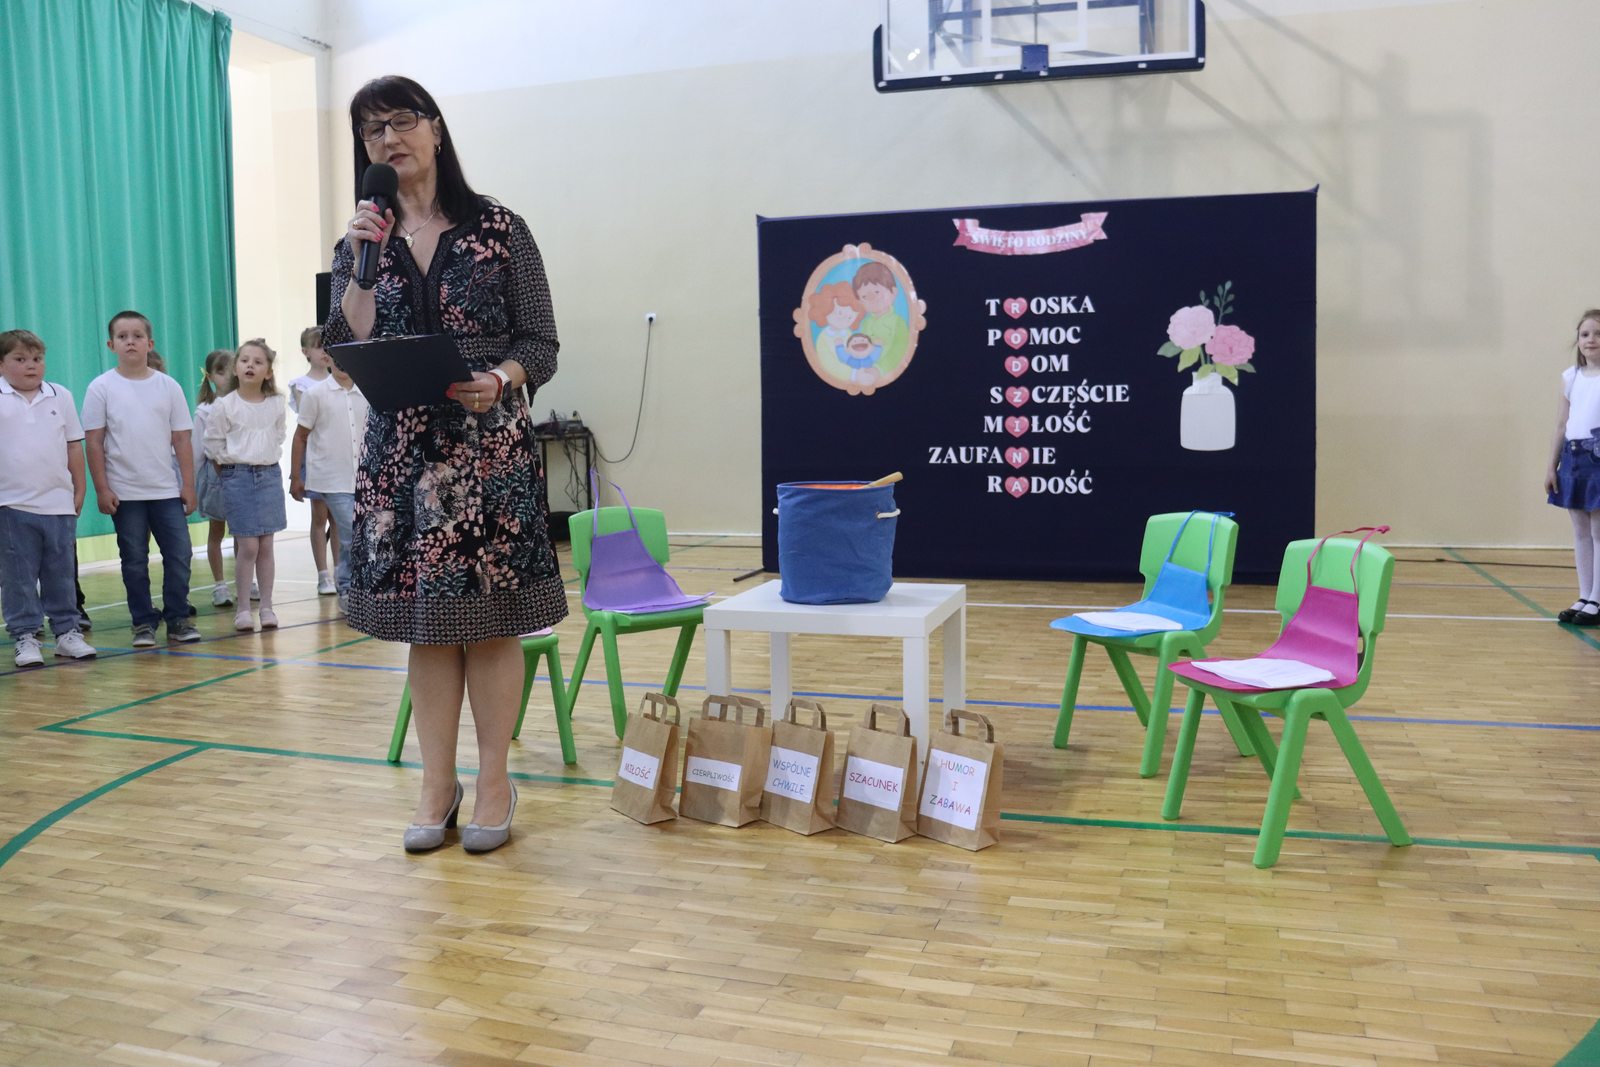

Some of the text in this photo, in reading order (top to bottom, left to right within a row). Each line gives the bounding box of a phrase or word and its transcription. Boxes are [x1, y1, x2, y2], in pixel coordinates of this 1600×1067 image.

[1026, 229, 1087, 247] RODZINY
[985, 296, 1095, 317] TROSKA
[987, 327, 1081, 346] POMOC
[1010, 354, 1069, 373] DOM
[928, 447, 1057, 465] ZAUFANIE
[987, 470, 1093, 494] RADOŚĆ
[692, 768, 735, 783] CIERPLIWOŚĆ
[772, 758, 812, 778] WSPÓLNE
[939, 760, 975, 777] HUMOR
[772, 778, 805, 795] CHWILE
[848, 772, 899, 793] SZACUNEK
[952, 781, 959, 792] I
[929, 794, 972, 815] ZABAWA
